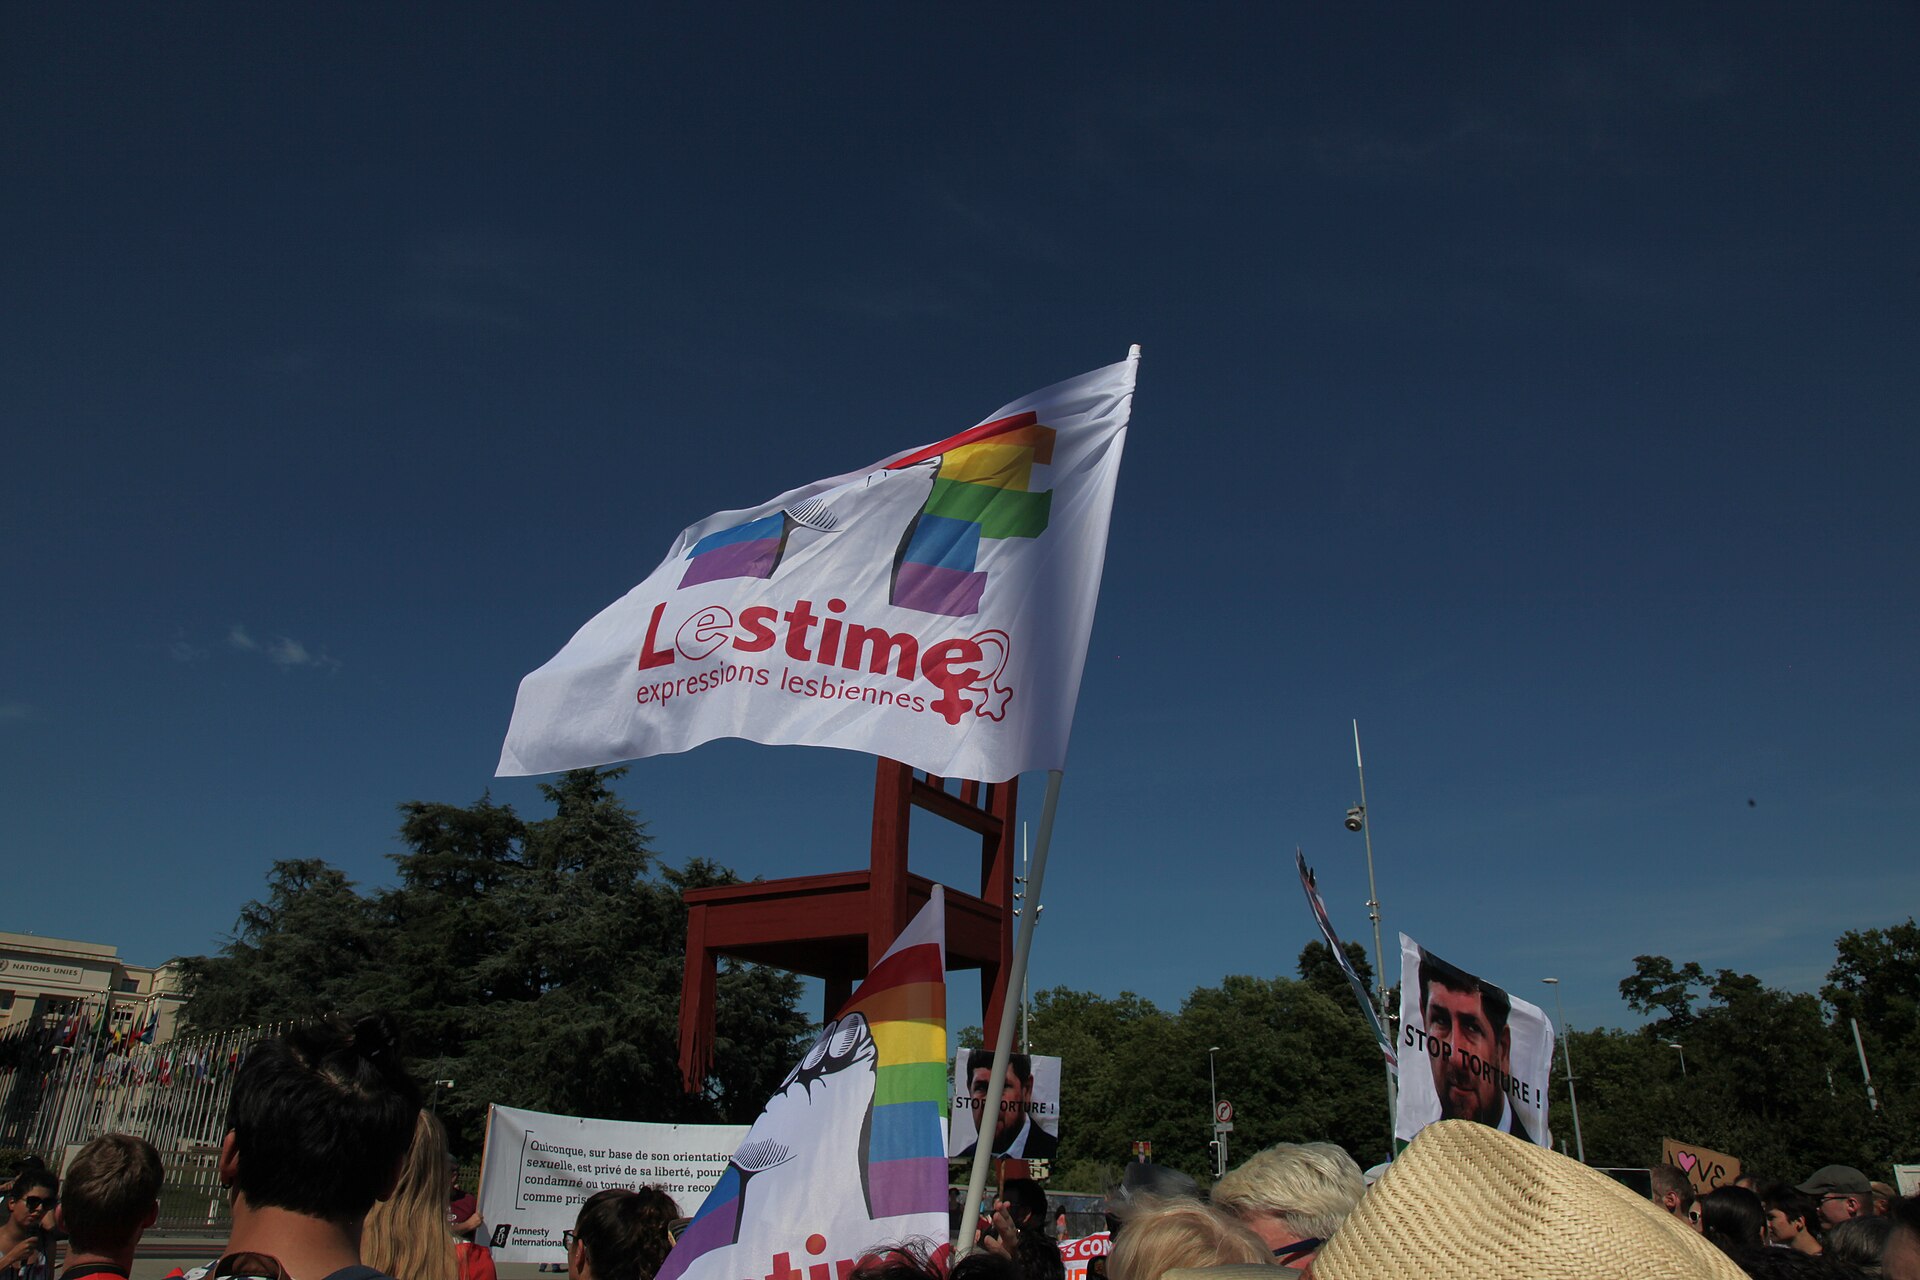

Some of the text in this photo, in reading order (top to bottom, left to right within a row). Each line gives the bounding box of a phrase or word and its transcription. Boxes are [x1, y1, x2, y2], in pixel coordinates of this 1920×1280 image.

[638, 598, 983, 690] Lestime
[637, 661, 925, 713] expressions lesbiennes
[13, 963, 78, 976] NATIONS UNIES
[1405, 1024, 1452, 1058] STOP
[1458, 1048, 1530, 1104] TORTURE
[1000, 1100, 1046, 1113] ORTURE
[530, 1140, 586, 1158] Quiconque,
[589, 1149, 606, 1158] sur
[608, 1149, 633, 1160] base
[635, 1151, 648, 1161] de
[651, 1153, 670, 1161] son
[526, 1158, 576, 1172] sexuelle,
[577, 1164, 592, 1173] est
[594, 1164, 622, 1175] privé
[624, 1166, 637, 1176] de
[640, 1168, 652, 1176] sa
[654, 1166, 694, 1178] liberté,
[524, 1175, 583, 1188] condamné
[586, 1181, 598, 1189] ou
[522, 1192, 563, 1203] comme
[512, 1226, 550, 1236] Amnesty
